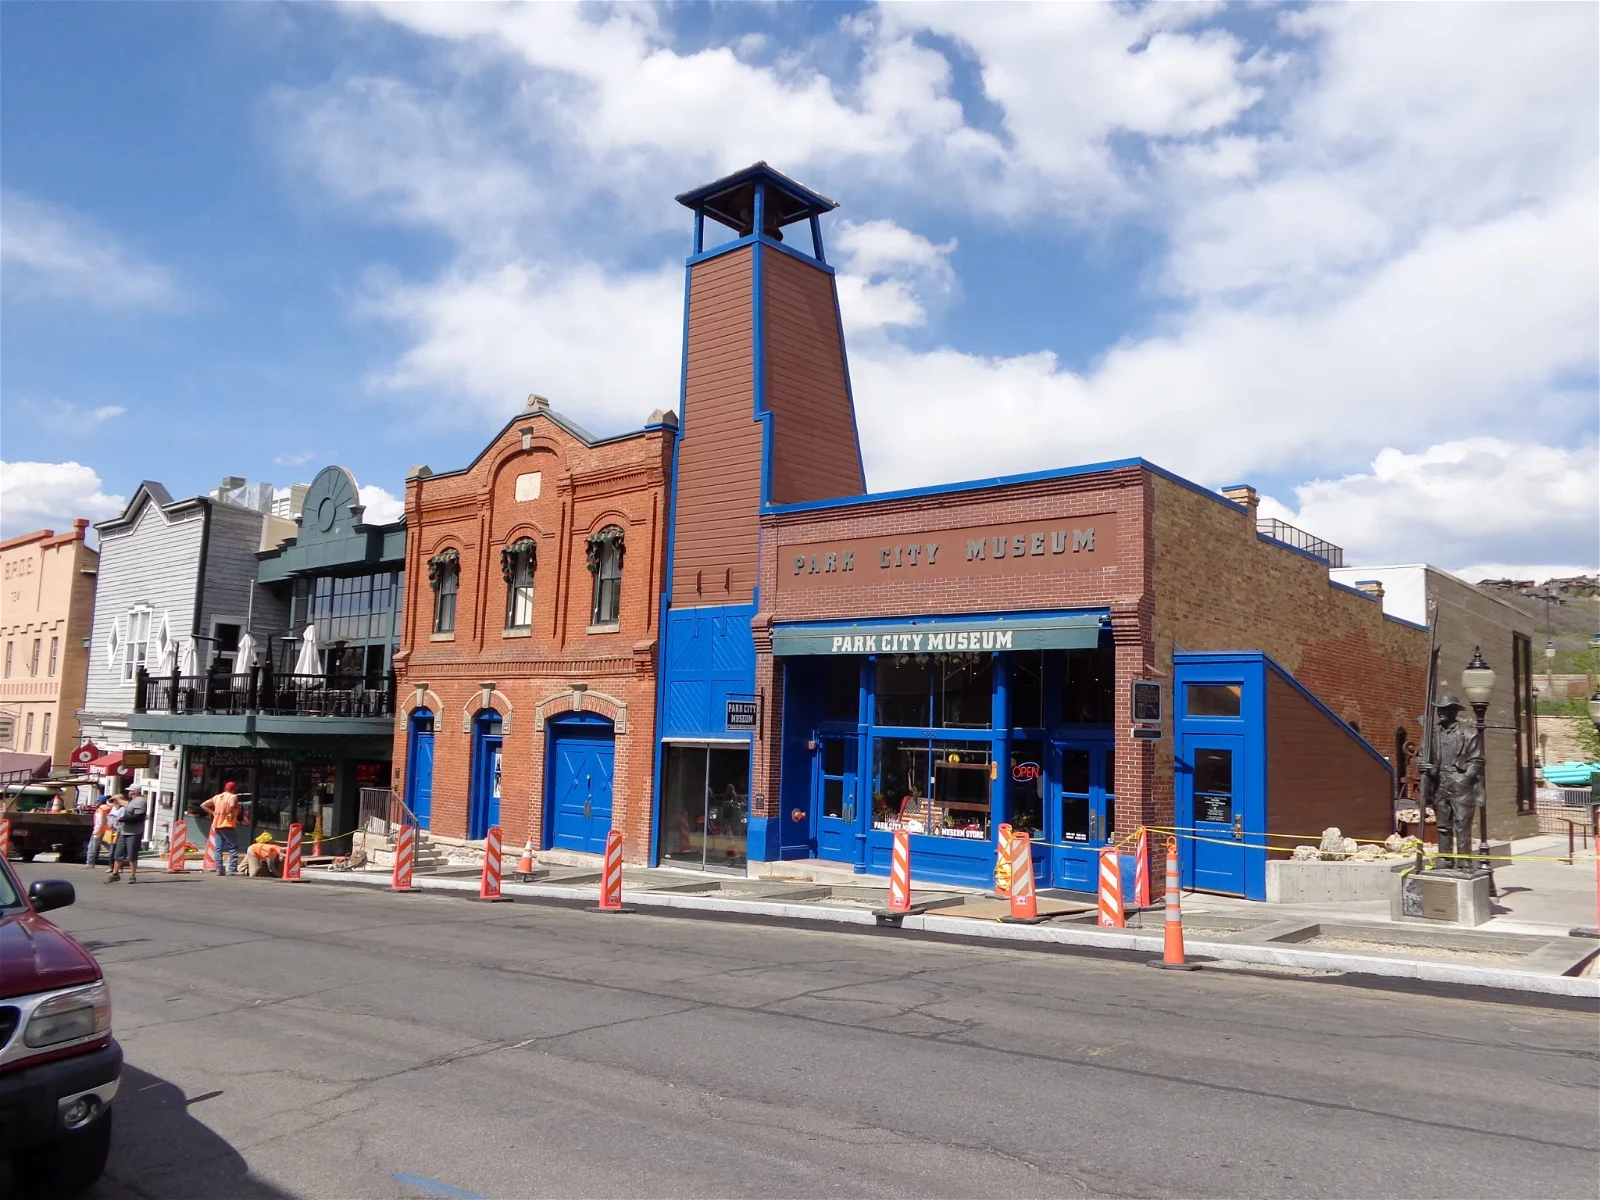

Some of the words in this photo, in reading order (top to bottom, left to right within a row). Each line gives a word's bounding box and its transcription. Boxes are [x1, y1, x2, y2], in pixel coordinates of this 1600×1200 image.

[793, 550, 855, 576] PARK
[879, 543, 940, 569] CITY
[966, 527, 1096, 562] MUSEUM
[831, 635, 877, 652] PARK
[881, 634, 923, 651] CITY
[927, 630, 1013, 650] MUSEUM
[728, 703, 743, 713] PARK
[743, 704, 757, 713] CITY
[731, 714, 753, 723] MUSEUM
[1012, 766, 1039, 778] OPEN
[941, 828, 965, 837] MUSEUM
[965, 830, 984, 839] STORE
